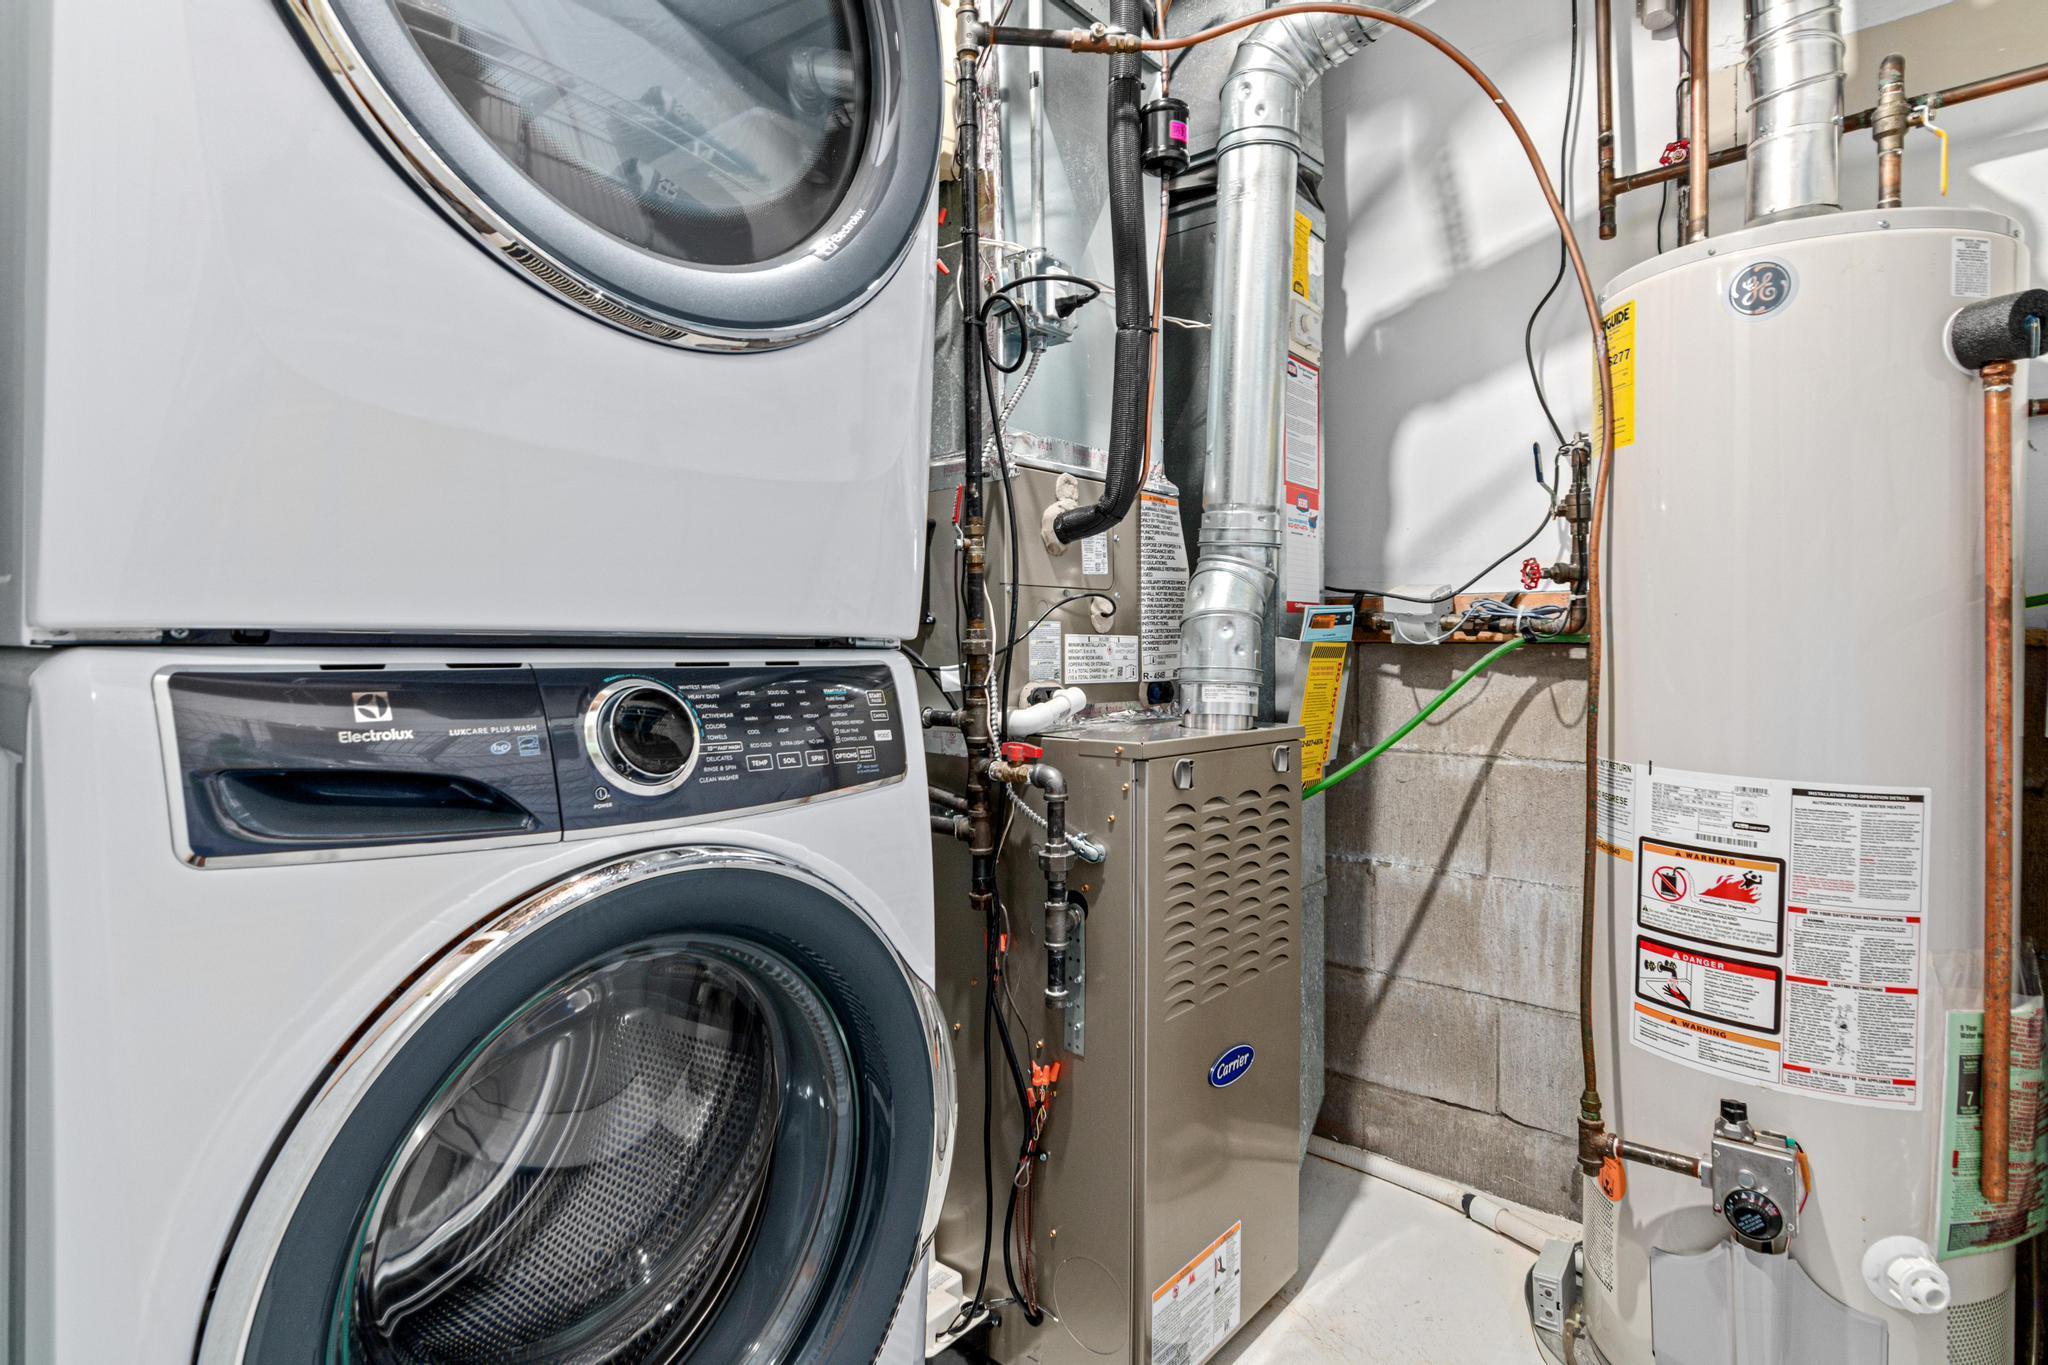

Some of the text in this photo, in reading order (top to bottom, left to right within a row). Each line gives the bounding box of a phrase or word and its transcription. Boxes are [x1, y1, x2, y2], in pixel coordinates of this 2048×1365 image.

[831, 209, 866, 249] Electrolux
[1335, 662, 1343, 683] DO
[1330, 686, 1338, 716] NOT
[337, 728, 414, 744] Electrolux
[448, 724, 537, 737] LUXCARE PLUS WASH
[751, 759, 768, 767] TEMP
[835, 752, 858, 760] OPTIONS
[1608, 761, 1632, 773] RETURN
[718, 774, 739, 782] WASHER
[1602, 792, 1628, 807] REGRESE
[1685, 852, 1735, 866] WARNING
[1682, 955, 1725, 969] DANGER
[1681, 1021, 1727, 1039] WARNING
[1217, 1053, 1250, 1079] Carrier
[1966, 1090, 1974, 1106] 7
